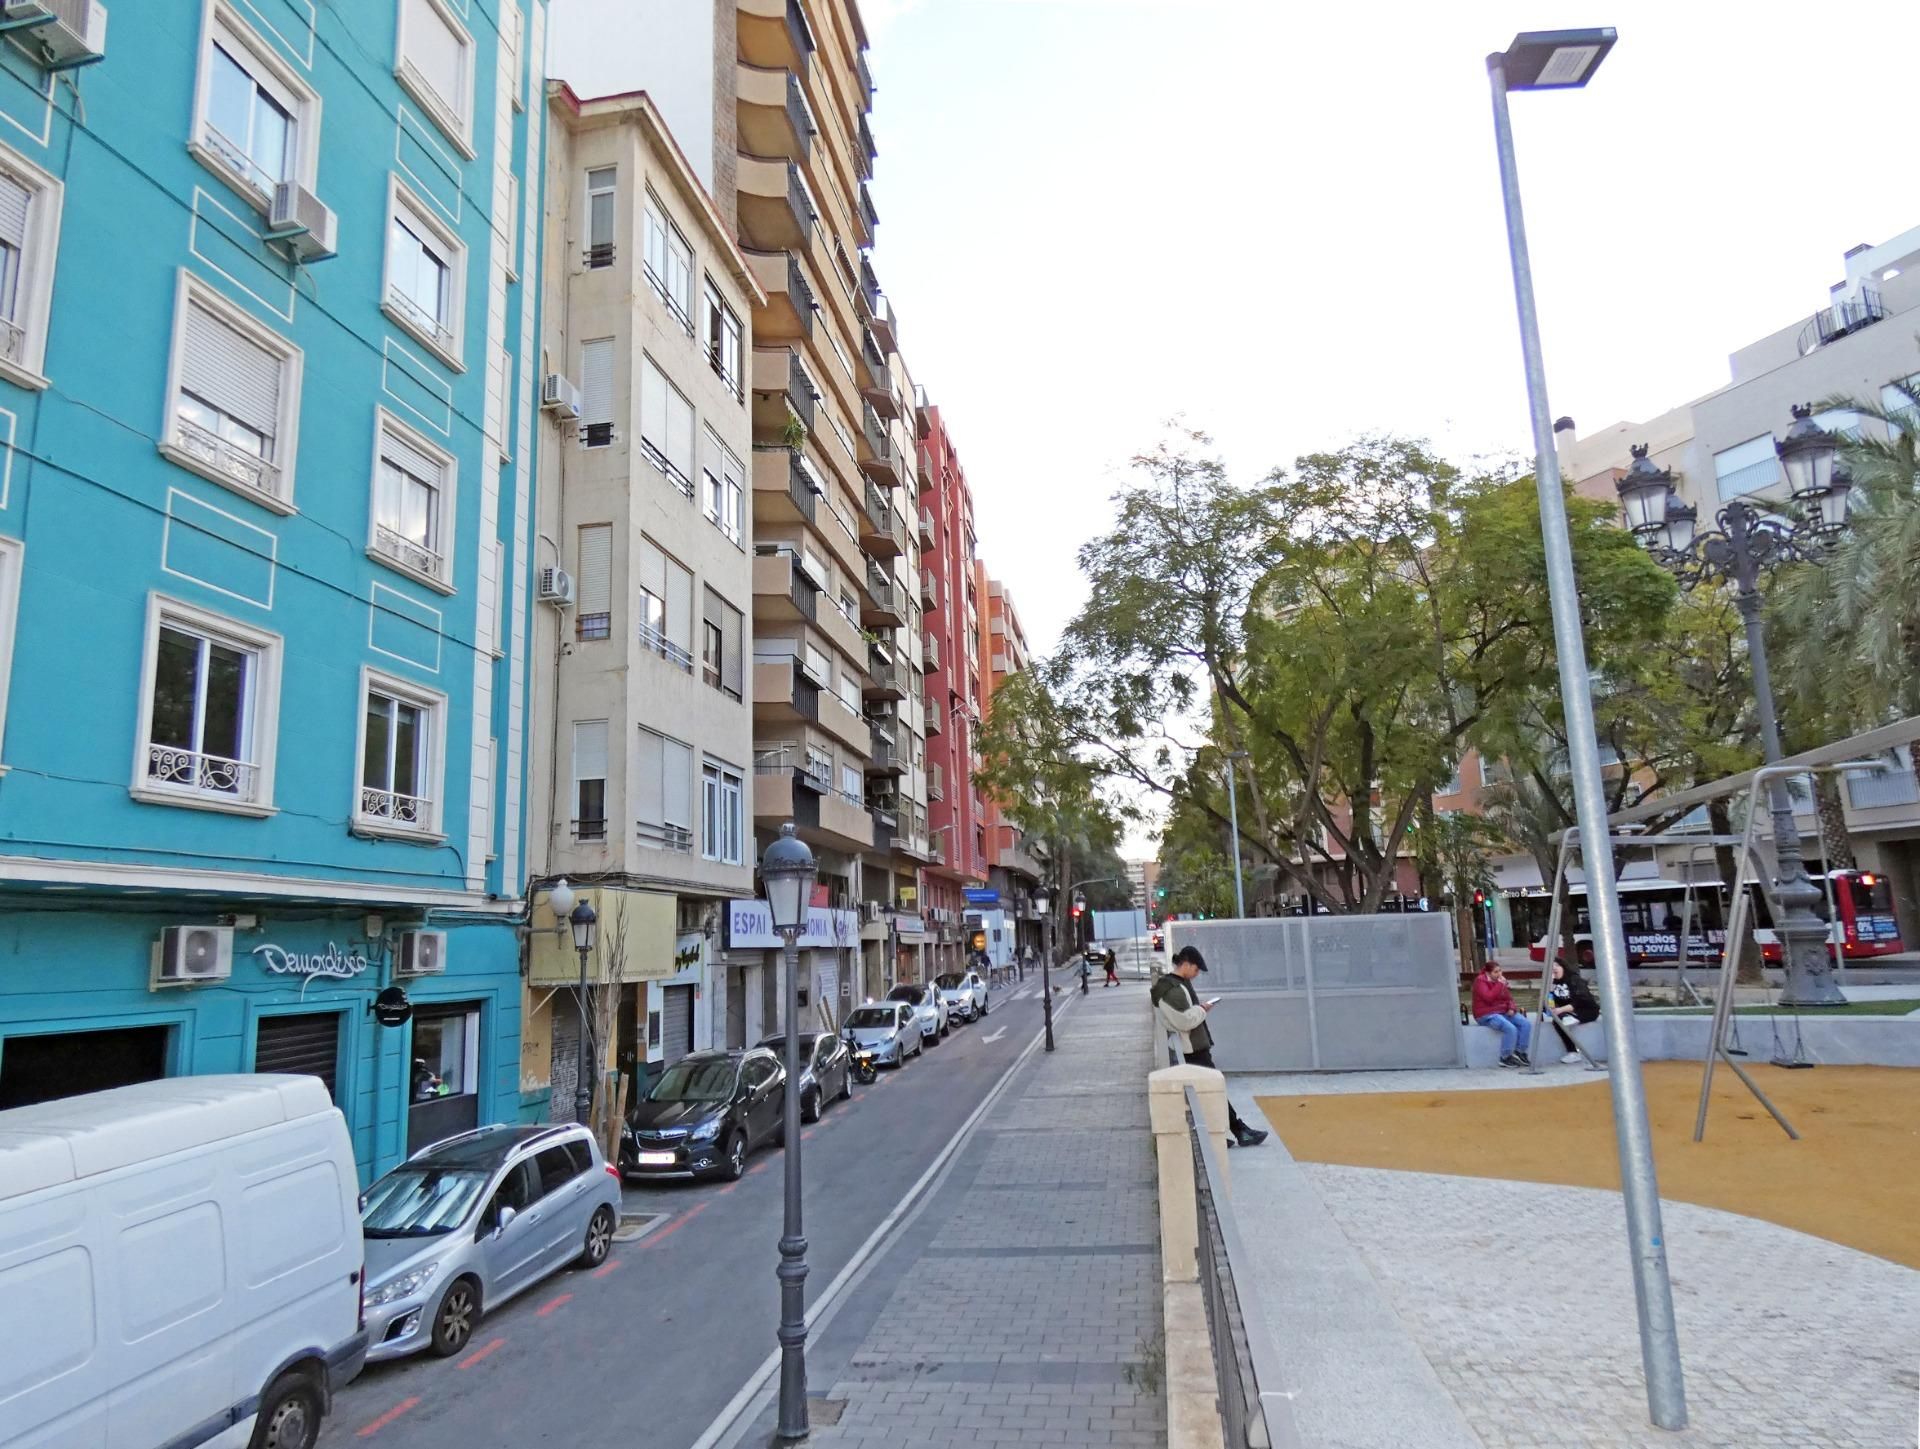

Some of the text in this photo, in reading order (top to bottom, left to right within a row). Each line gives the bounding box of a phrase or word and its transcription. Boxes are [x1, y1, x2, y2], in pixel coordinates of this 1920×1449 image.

[734, 912, 766, 935] ESPAI
[1628, 933, 1676, 944] EMPEÑOS
[1630, 944, 1678, 953] DE JOYAS
